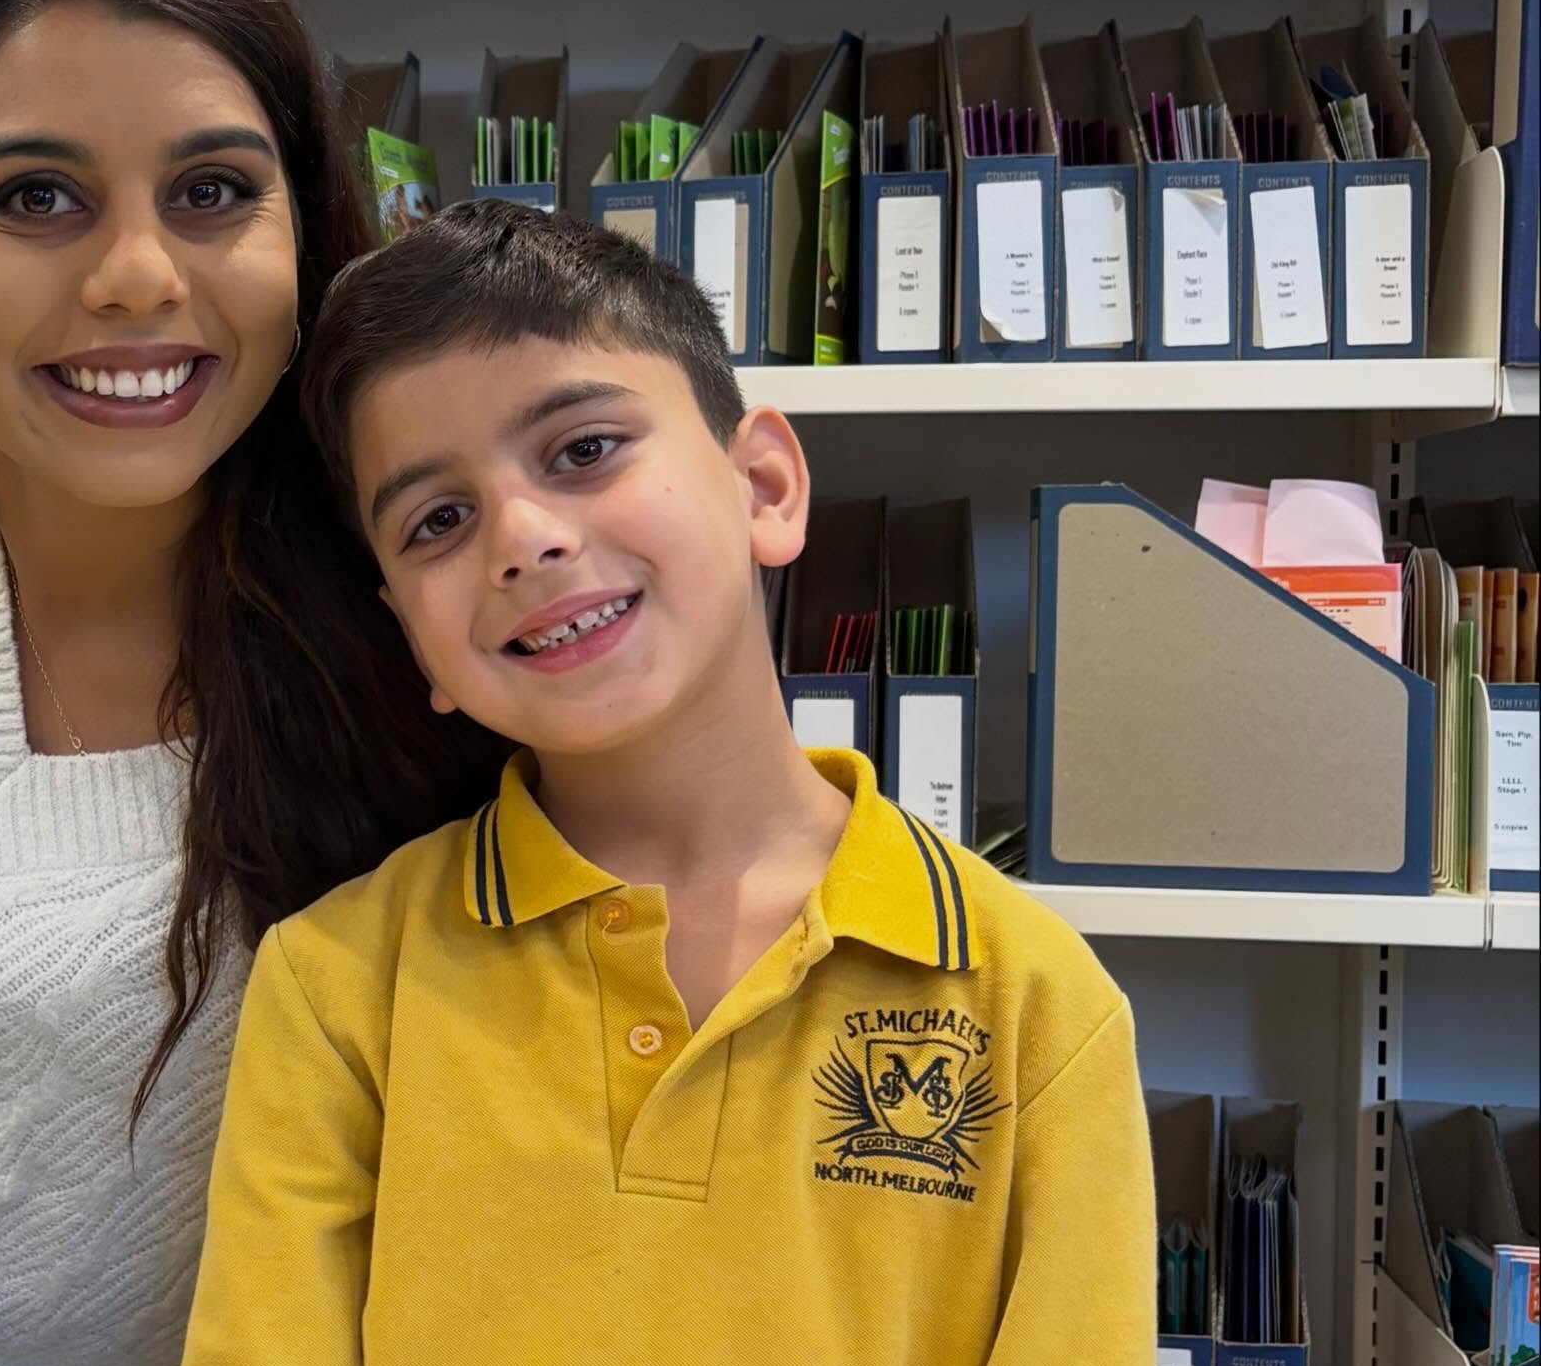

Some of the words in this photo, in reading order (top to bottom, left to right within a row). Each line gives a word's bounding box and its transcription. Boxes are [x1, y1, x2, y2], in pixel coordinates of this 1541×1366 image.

[986, 171, 1041, 182] CONTENTS
[1168, 175, 1221, 185] CONTENTS
[1355, 174, 1410, 185] CONTENTS
[1258, 177, 1313, 188] CONTENTS
[881, 185, 933, 196] CONTENTS
[1490, 698, 1539, 708] CONTENT
[1497, 786, 1520, 795] Stage
[1501, 824, 1528, 832] copies
[856, 1137, 883, 1150] GOD
[885, 1137, 897, 1149] IS
[899, 1139, 923, 1153] OUR
